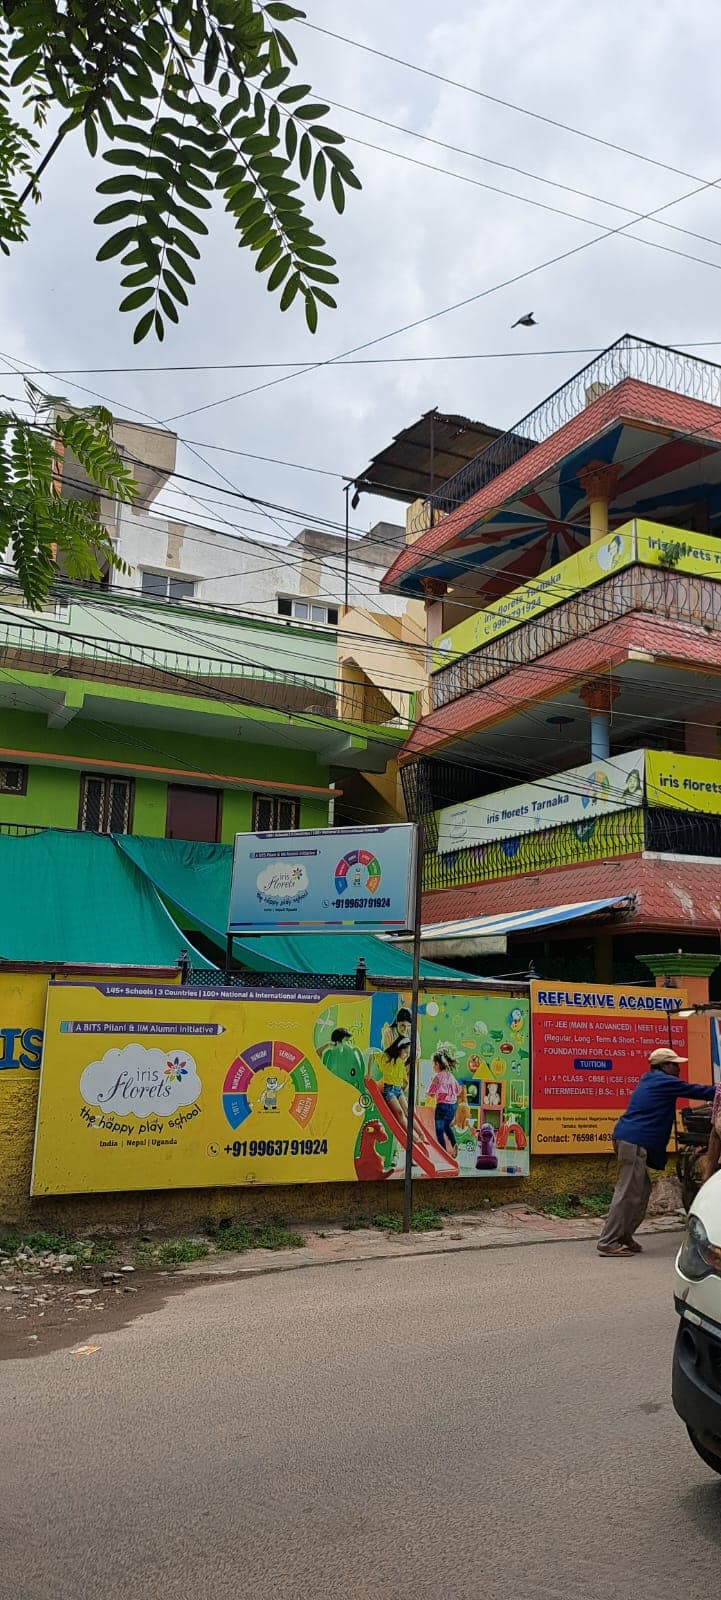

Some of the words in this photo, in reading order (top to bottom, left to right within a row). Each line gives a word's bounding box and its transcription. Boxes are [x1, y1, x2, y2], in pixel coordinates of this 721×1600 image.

[659, 772, 679, 788] iris
[486, 813, 500, 825] iris
[501, 805, 529, 820] florets
[531, 794, 570, 812] Tarnaka
[280, 873, 290, 881] iris
[164, 989, 198, 997] Countries
[537, 991, 615, 1007] REFLEXIVE
[619, 995, 683, 1011] ACADEMY
[83, 1024, 101, 1032] BITS
[103, 1024, 126, 1032] Pilani
[137, 1025, 149, 1033] IIM
[150, 1025, 178, 1033] Alumni
[179, 1025, 214, 1033] Initiative
[569, 1021, 588, 1030] (MAIN
[595, 1022, 632, 1031] ADVANCED)
[638, 1024, 654, 1032] NEET
[658, 1025, 684, 1033] EACET
[574, 1035, 591, 1043] Long
[618, 1036, 635, 1044] Short
[544, 1047, 588, 1056] FOUNDATION
[589, 1048, 603, 1056] FOR
[604, 1049, 626, 1057] CLASS
[137, 1067, 159, 1082] iris
[231, 1066, 246, 1090] NURSERY
[588, 1075, 605, 1083] CBSE
[97, 1070, 172, 1103] florets
[544, 1087, 594, 1095] INTERMEDIATE
[80, 1106, 96, 1124] the
[98, 1115, 135, 1136] happy
[138, 1119, 164, 1135] play
[168, 1103, 203, 1128] school
[126, 1139, 147, 1147] Nepal
[151, 1138, 178, 1147] Uganda
[536, 1133, 570, 1143] Contact:
[572, 1133, 614, 1142] 765981493
